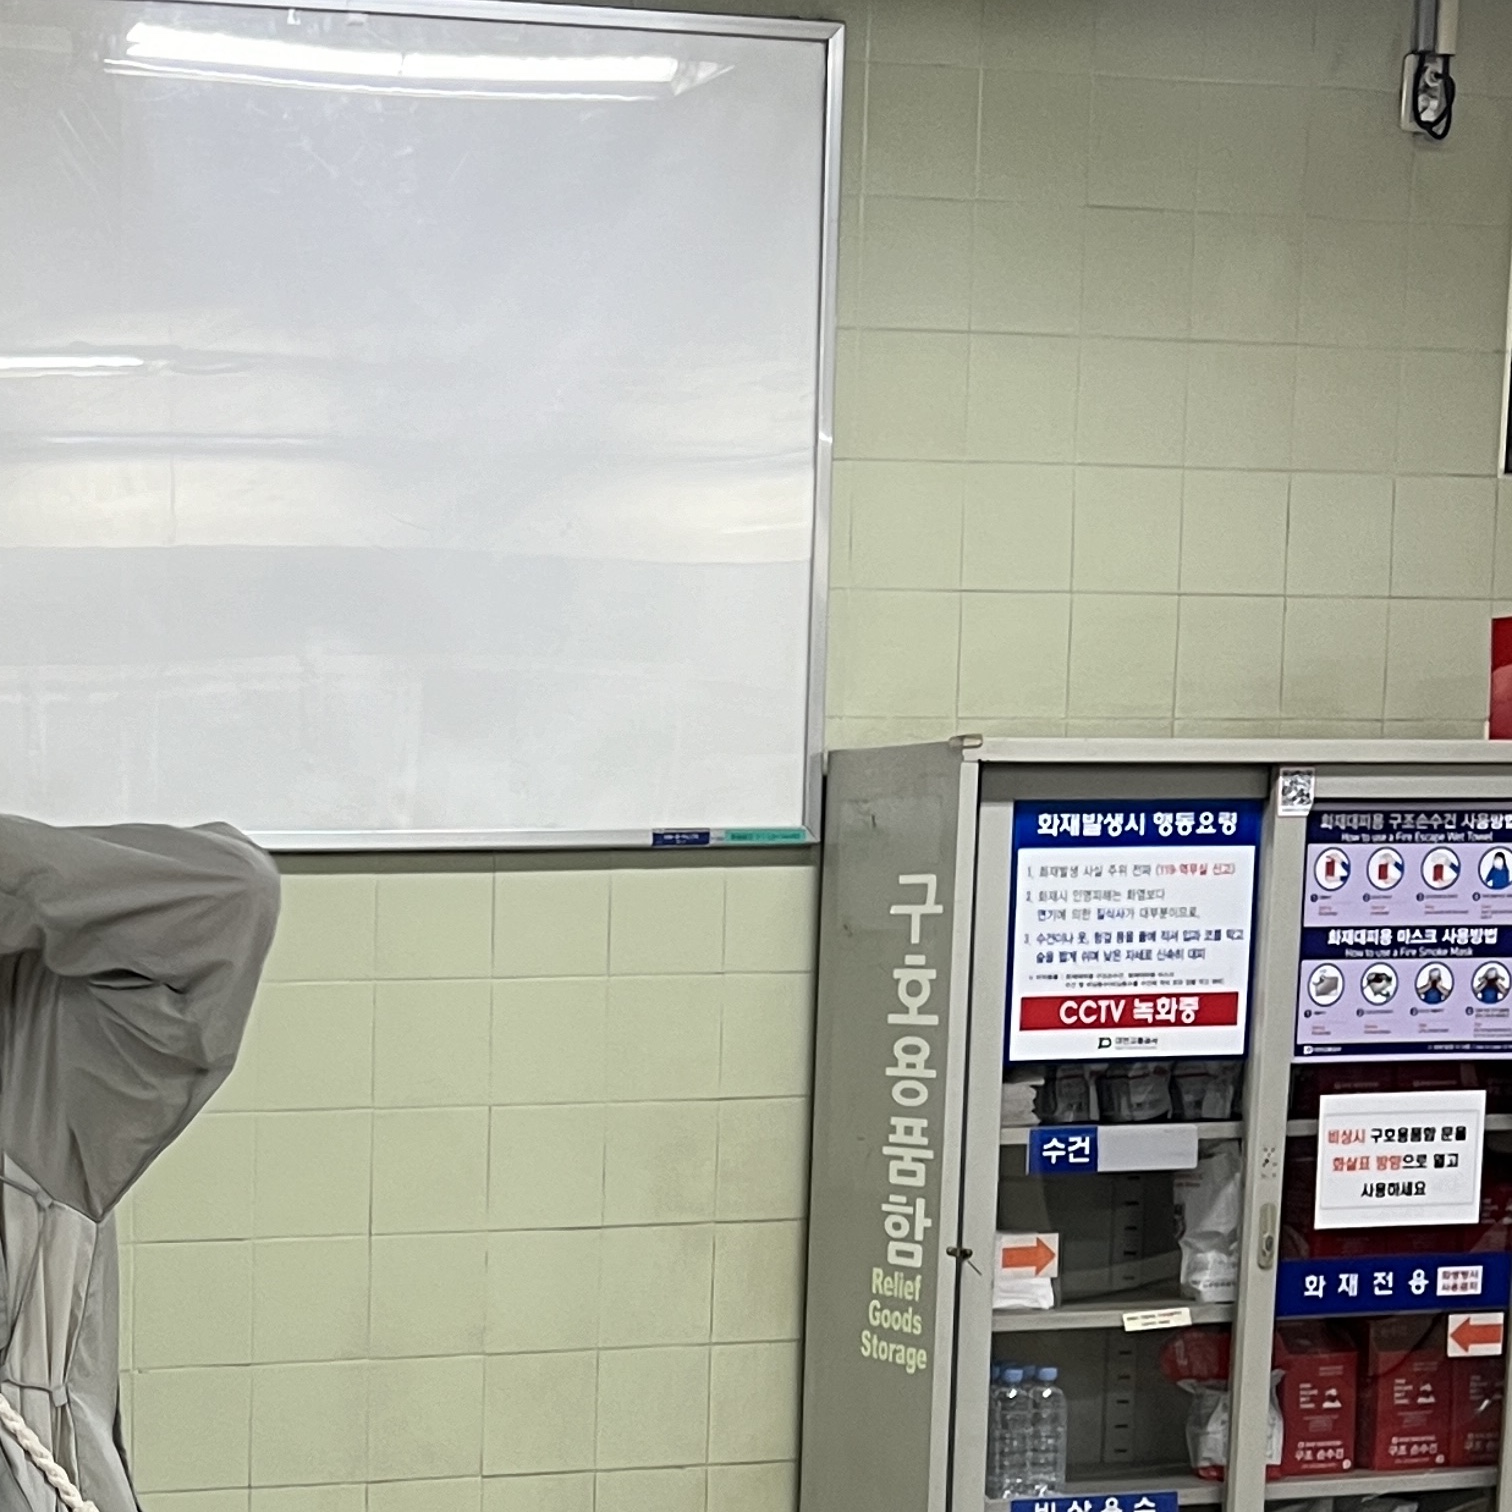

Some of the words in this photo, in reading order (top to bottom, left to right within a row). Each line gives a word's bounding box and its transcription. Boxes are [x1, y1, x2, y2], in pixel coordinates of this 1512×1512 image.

[1037, 812, 1145, 837] 화재발생시
[1153, 811, 1238, 837] 행동요령
[1320, 813, 1384, 830] 화재대피용
[1389, 812, 1457, 830] 구조손수건
[1341, 832, 1360, 842] How
[1361, 832, 1370, 842] to
[1372, 834, 1387, 843] use
[1395, 831, 1412, 842] Fire
[1414, 832, 1445, 844] Escape
[1447, 831, 1465, 842] Wet
[1467, 831, 1493, 842] Towel
[1039, 865, 1079, 878] 화재발생
[1083, 864, 1103, 877] 사실
[1107, 864, 1128, 877] 주위
[1038, 890, 1067, 902] 화재시
[1072, 889, 1122, 902] 인명피해는
[1036, 932, 1074, 945] 수건이나
[1328, 929, 1392, 945] 화재대피용
[1397, 928, 1437, 944] 마스크
[1442, 928, 1498, 944] 사용방법
[1345, 948, 1364, 958] How
[1365, 948, 1374, 957] to
[1376, 949, 1391, 957] use
[1400, 947, 1416, 957] Fire
[1419, 947, 1449, 957] Smoke
[1450, 946, 1473, 956] Mask
[1059, 999, 1126, 1024] CCTV
[1133, 996, 1200, 1024] 녹화중
[881, 874, 944, 1268] 구호용품함
[1327, 1129, 1366, 1145] 비상시
[1042, 1136, 1090, 1164] 수건
[1332, 1155, 1370, 1172] 화살표
[1376, 1153, 1427, 1171] 방향으로
[1433, 1153, 1459, 1169] 열고
[1361, 1181, 1426, 1198] 사용하세요
[872, 1267, 922, 1301] Relief
[868, 1300, 922, 1335] Goods
[860, 1330, 927, 1374] Storage
